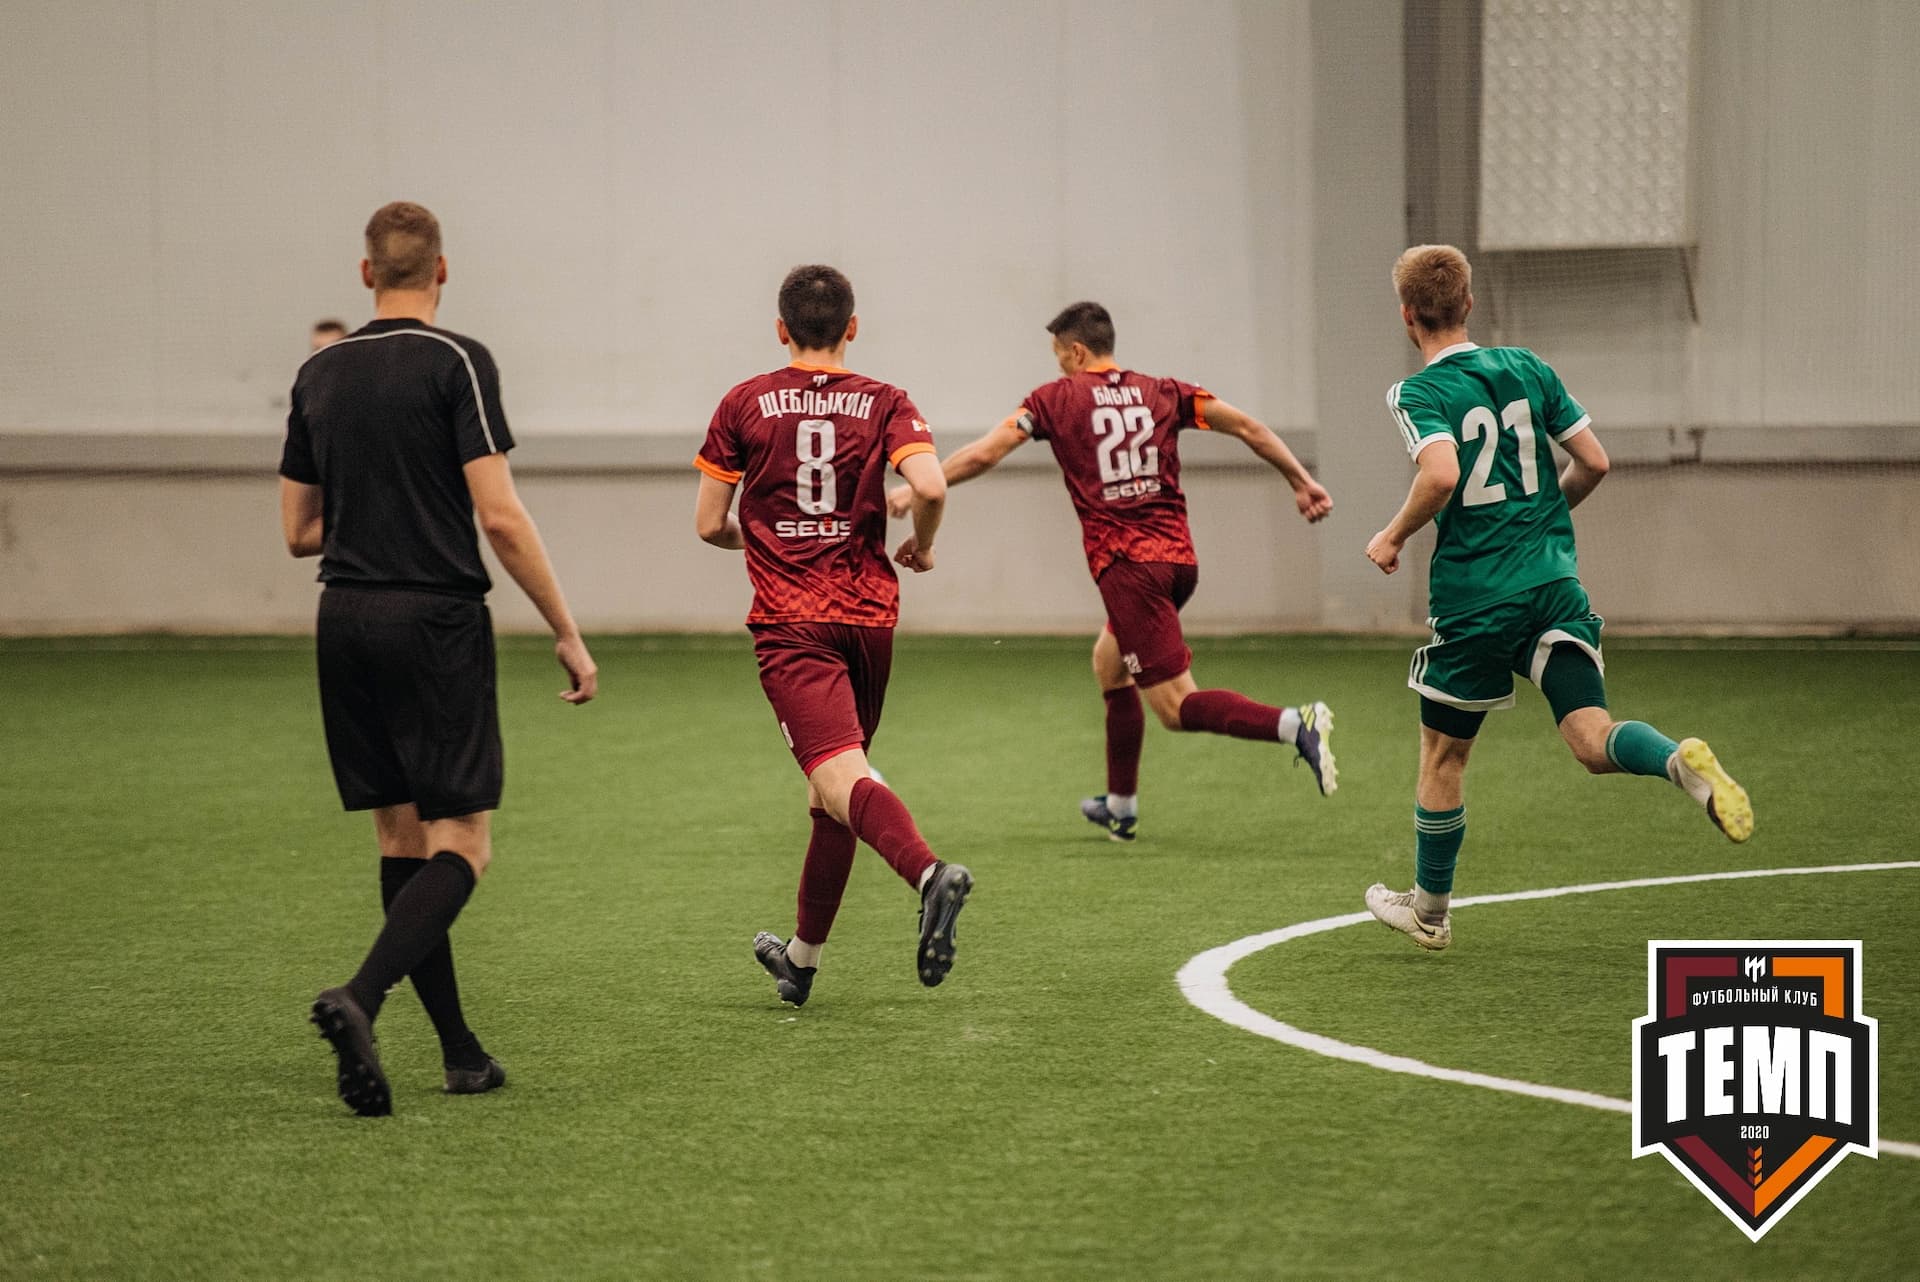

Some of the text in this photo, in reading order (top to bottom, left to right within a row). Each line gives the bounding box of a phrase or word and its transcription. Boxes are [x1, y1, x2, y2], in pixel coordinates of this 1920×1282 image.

[758, 388, 874, 420] ЩЕБЛЫКИН
[1091, 385, 1143, 406] БАБИЧ
[796, 419, 837, 515] 8
[1091, 405, 1160, 484] 22
[1462, 398, 1539, 507] 21
[1103, 478, 1161, 501] SEUS
